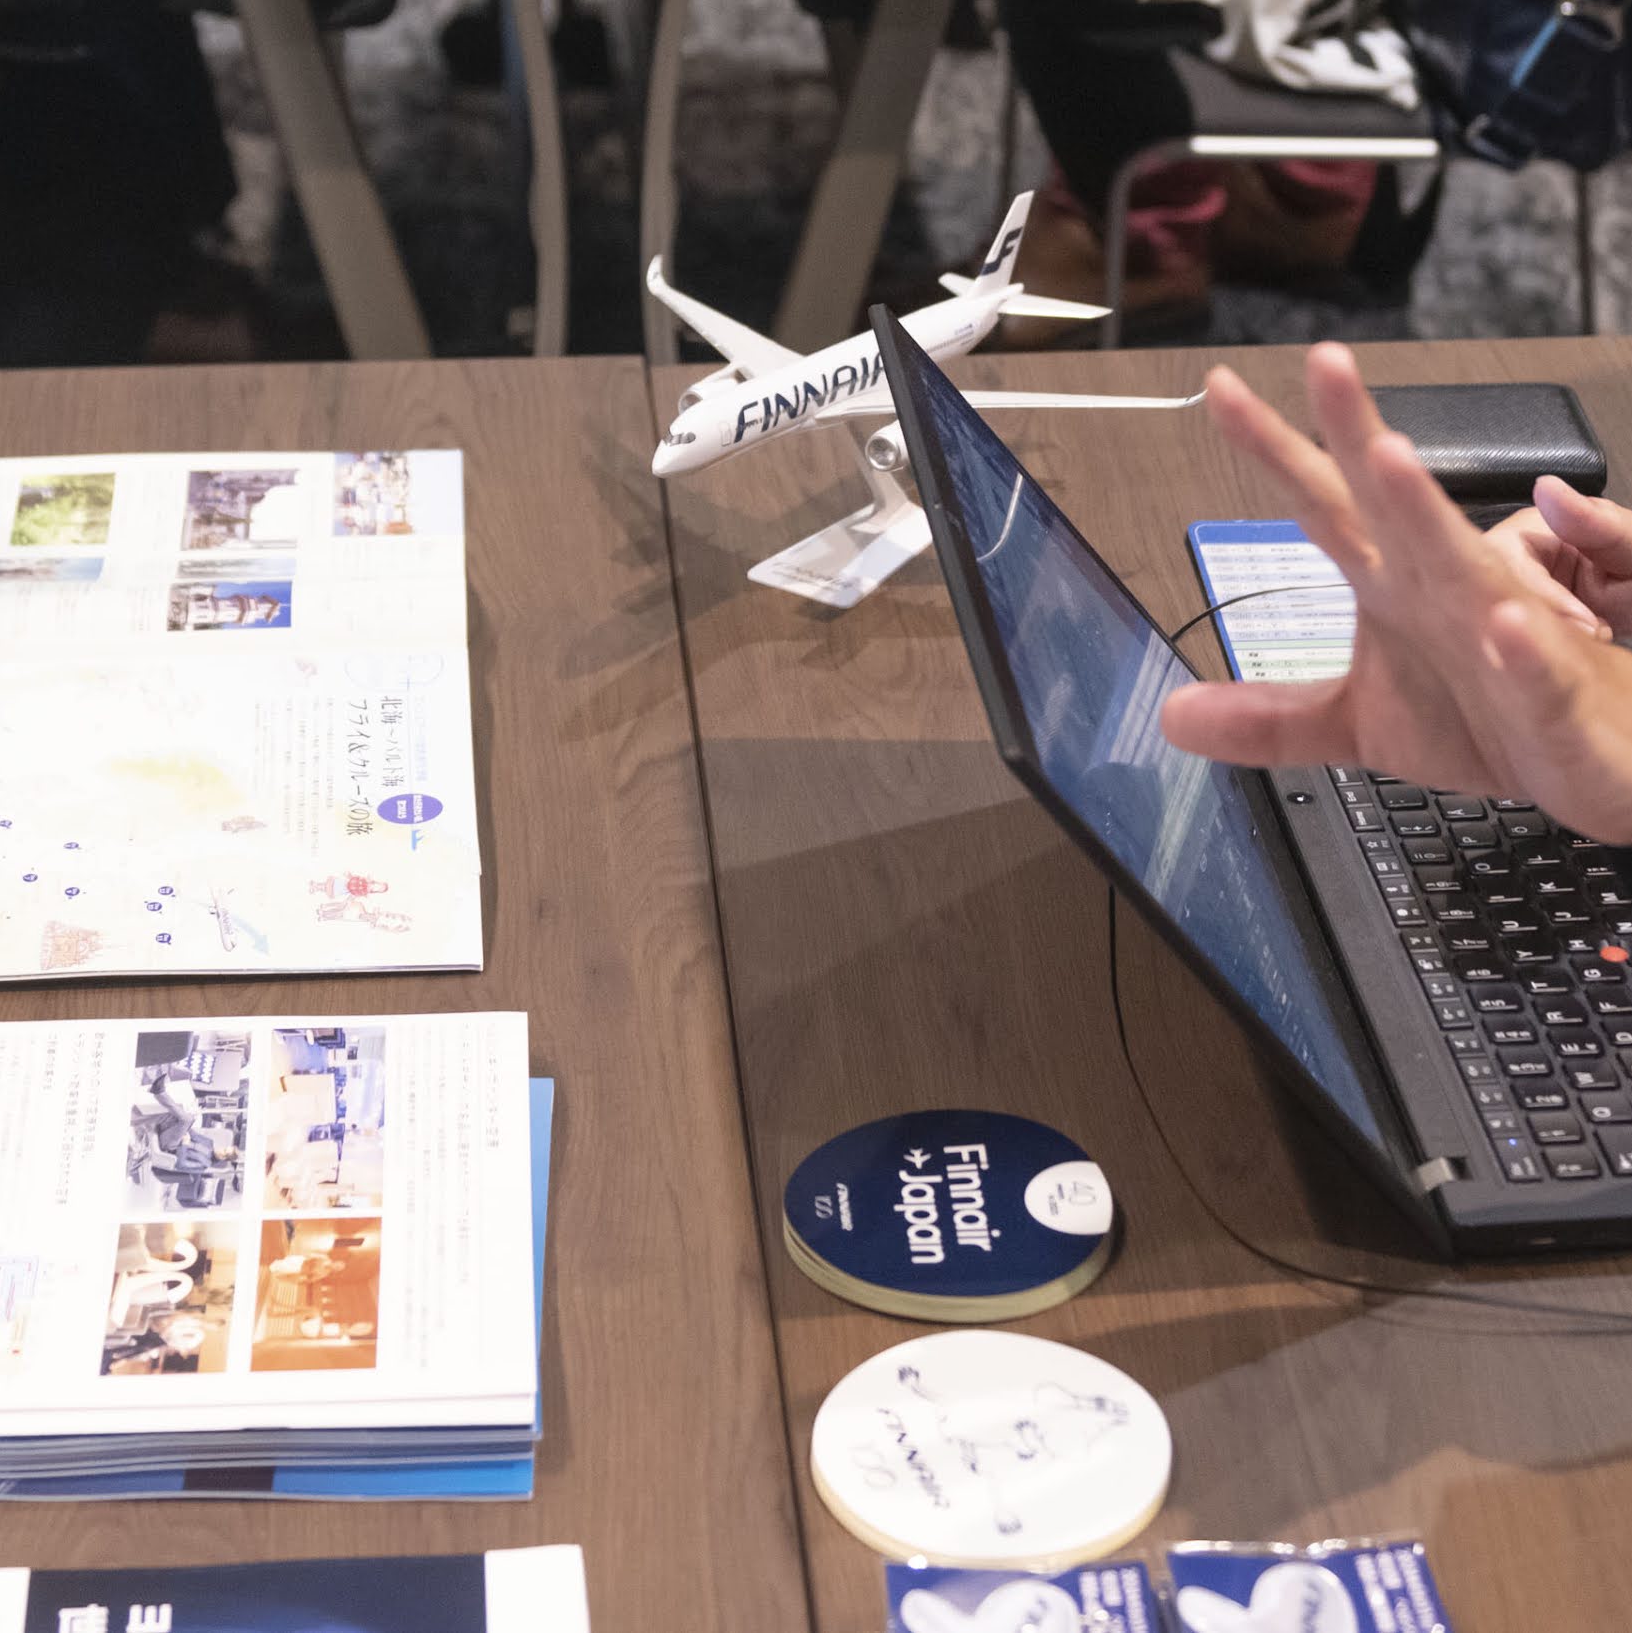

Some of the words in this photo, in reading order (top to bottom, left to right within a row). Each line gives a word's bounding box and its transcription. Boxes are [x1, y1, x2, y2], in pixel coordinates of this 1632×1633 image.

[1583, 968, 1601, 978] G
[893, 1169, 946, 1265] Japan
[943, 1143, 1002, 1253] Finnair
